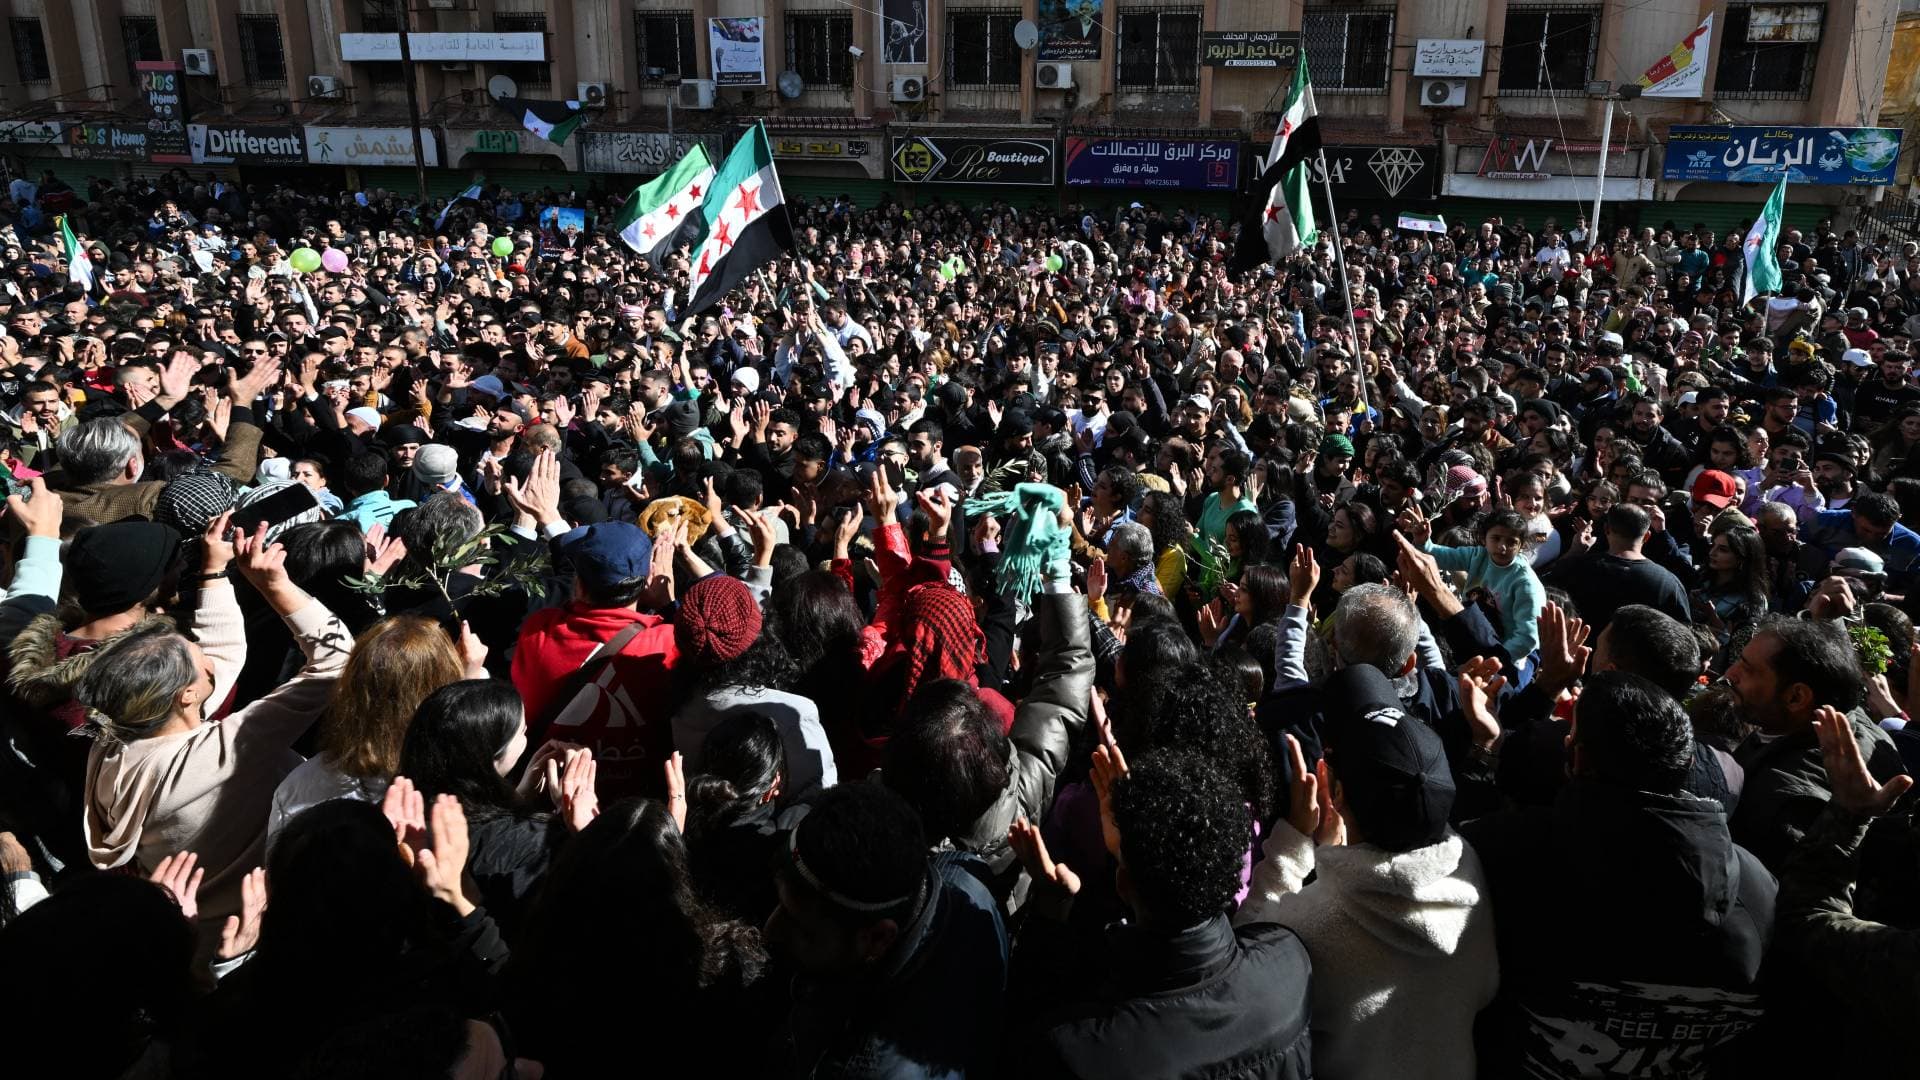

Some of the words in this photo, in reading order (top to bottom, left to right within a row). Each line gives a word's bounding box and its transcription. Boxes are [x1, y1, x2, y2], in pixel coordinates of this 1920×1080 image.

[149, 91, 179, 106] Home
[111, 128, 147, 147] Home
[208, 129, 303, 155] Different
[1763, 130, 1794, 139] وكالة
[986, 151, 1045, 166] Boutique
[1091, 142, 1160, 161] للإتصالات
[1164, 143, 1195, 161] البرق
[1199, 143, 1232, 161] مركز
[1112, 163, 1132, 174] مفرق
[1133, 165, 1139, 174] و
[1141, 164, 1159, 173] جملة
[1688, 160, 1711, 168] IATA
[1604, 1016, 1664, 1041] FEEL
